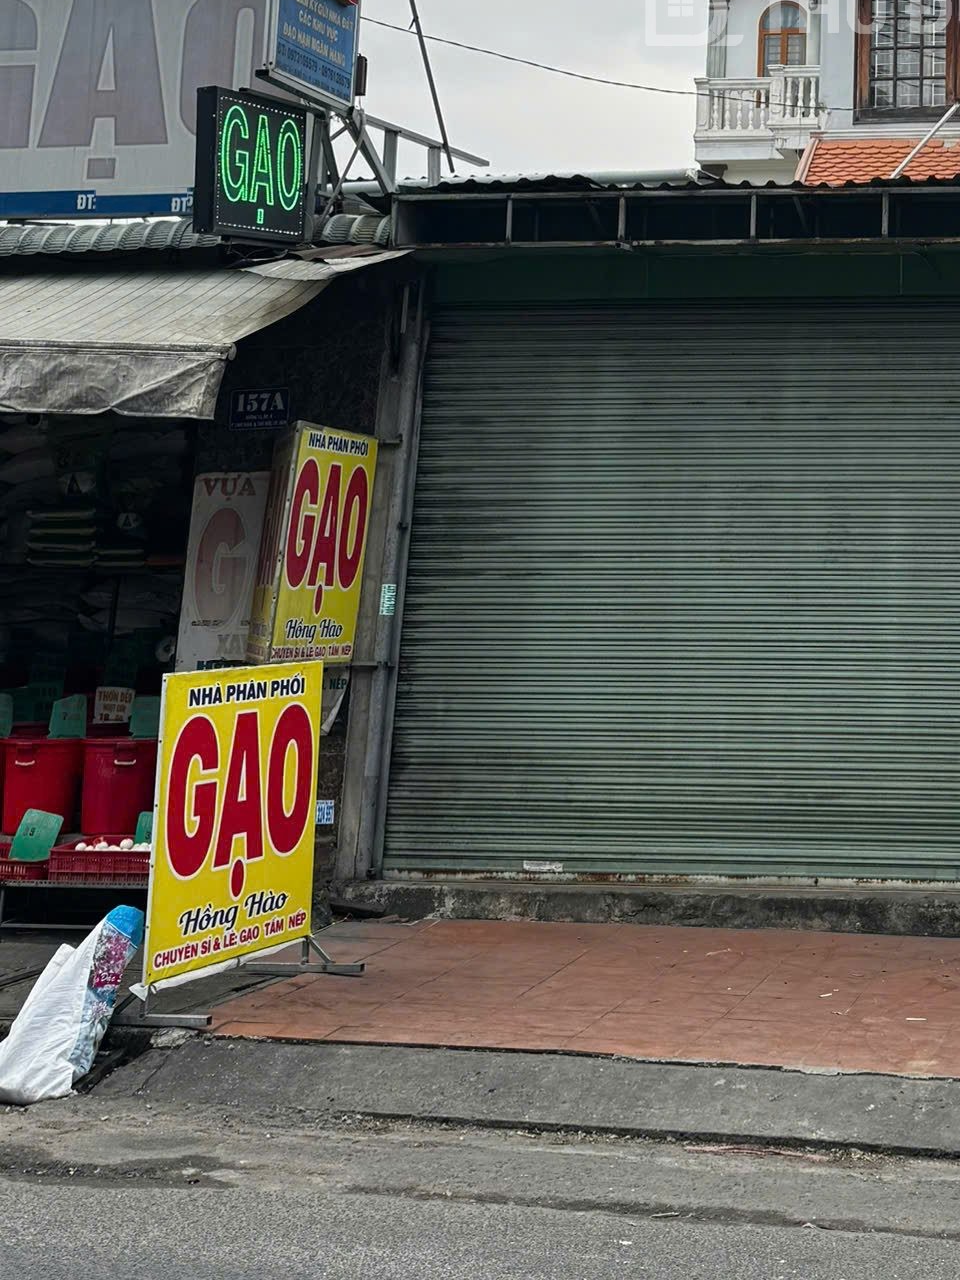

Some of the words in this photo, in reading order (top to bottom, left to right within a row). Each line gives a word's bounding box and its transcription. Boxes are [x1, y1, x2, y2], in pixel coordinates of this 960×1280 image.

[220, 104, 303, 225] GẠO
[237, 392, 286, 413] 157A
[285, 457, 369, 616] GẠO
[189, 683, 222, 707] NHÀ
[226, 680, 268, 703] PHÂN
[270, 673, 305, 698] PHỐI
[166, 703, 314, 900] GẠO
[154, 942, 198, 969] CHUYÊN
[213, 941, 221, 952] &
[239, 926, 260, 945] GẠO
[288, 908, 307, 928] NẾP
[179, 904, 239, 936] Hồng
[244, 890, 289, 917] Hào
